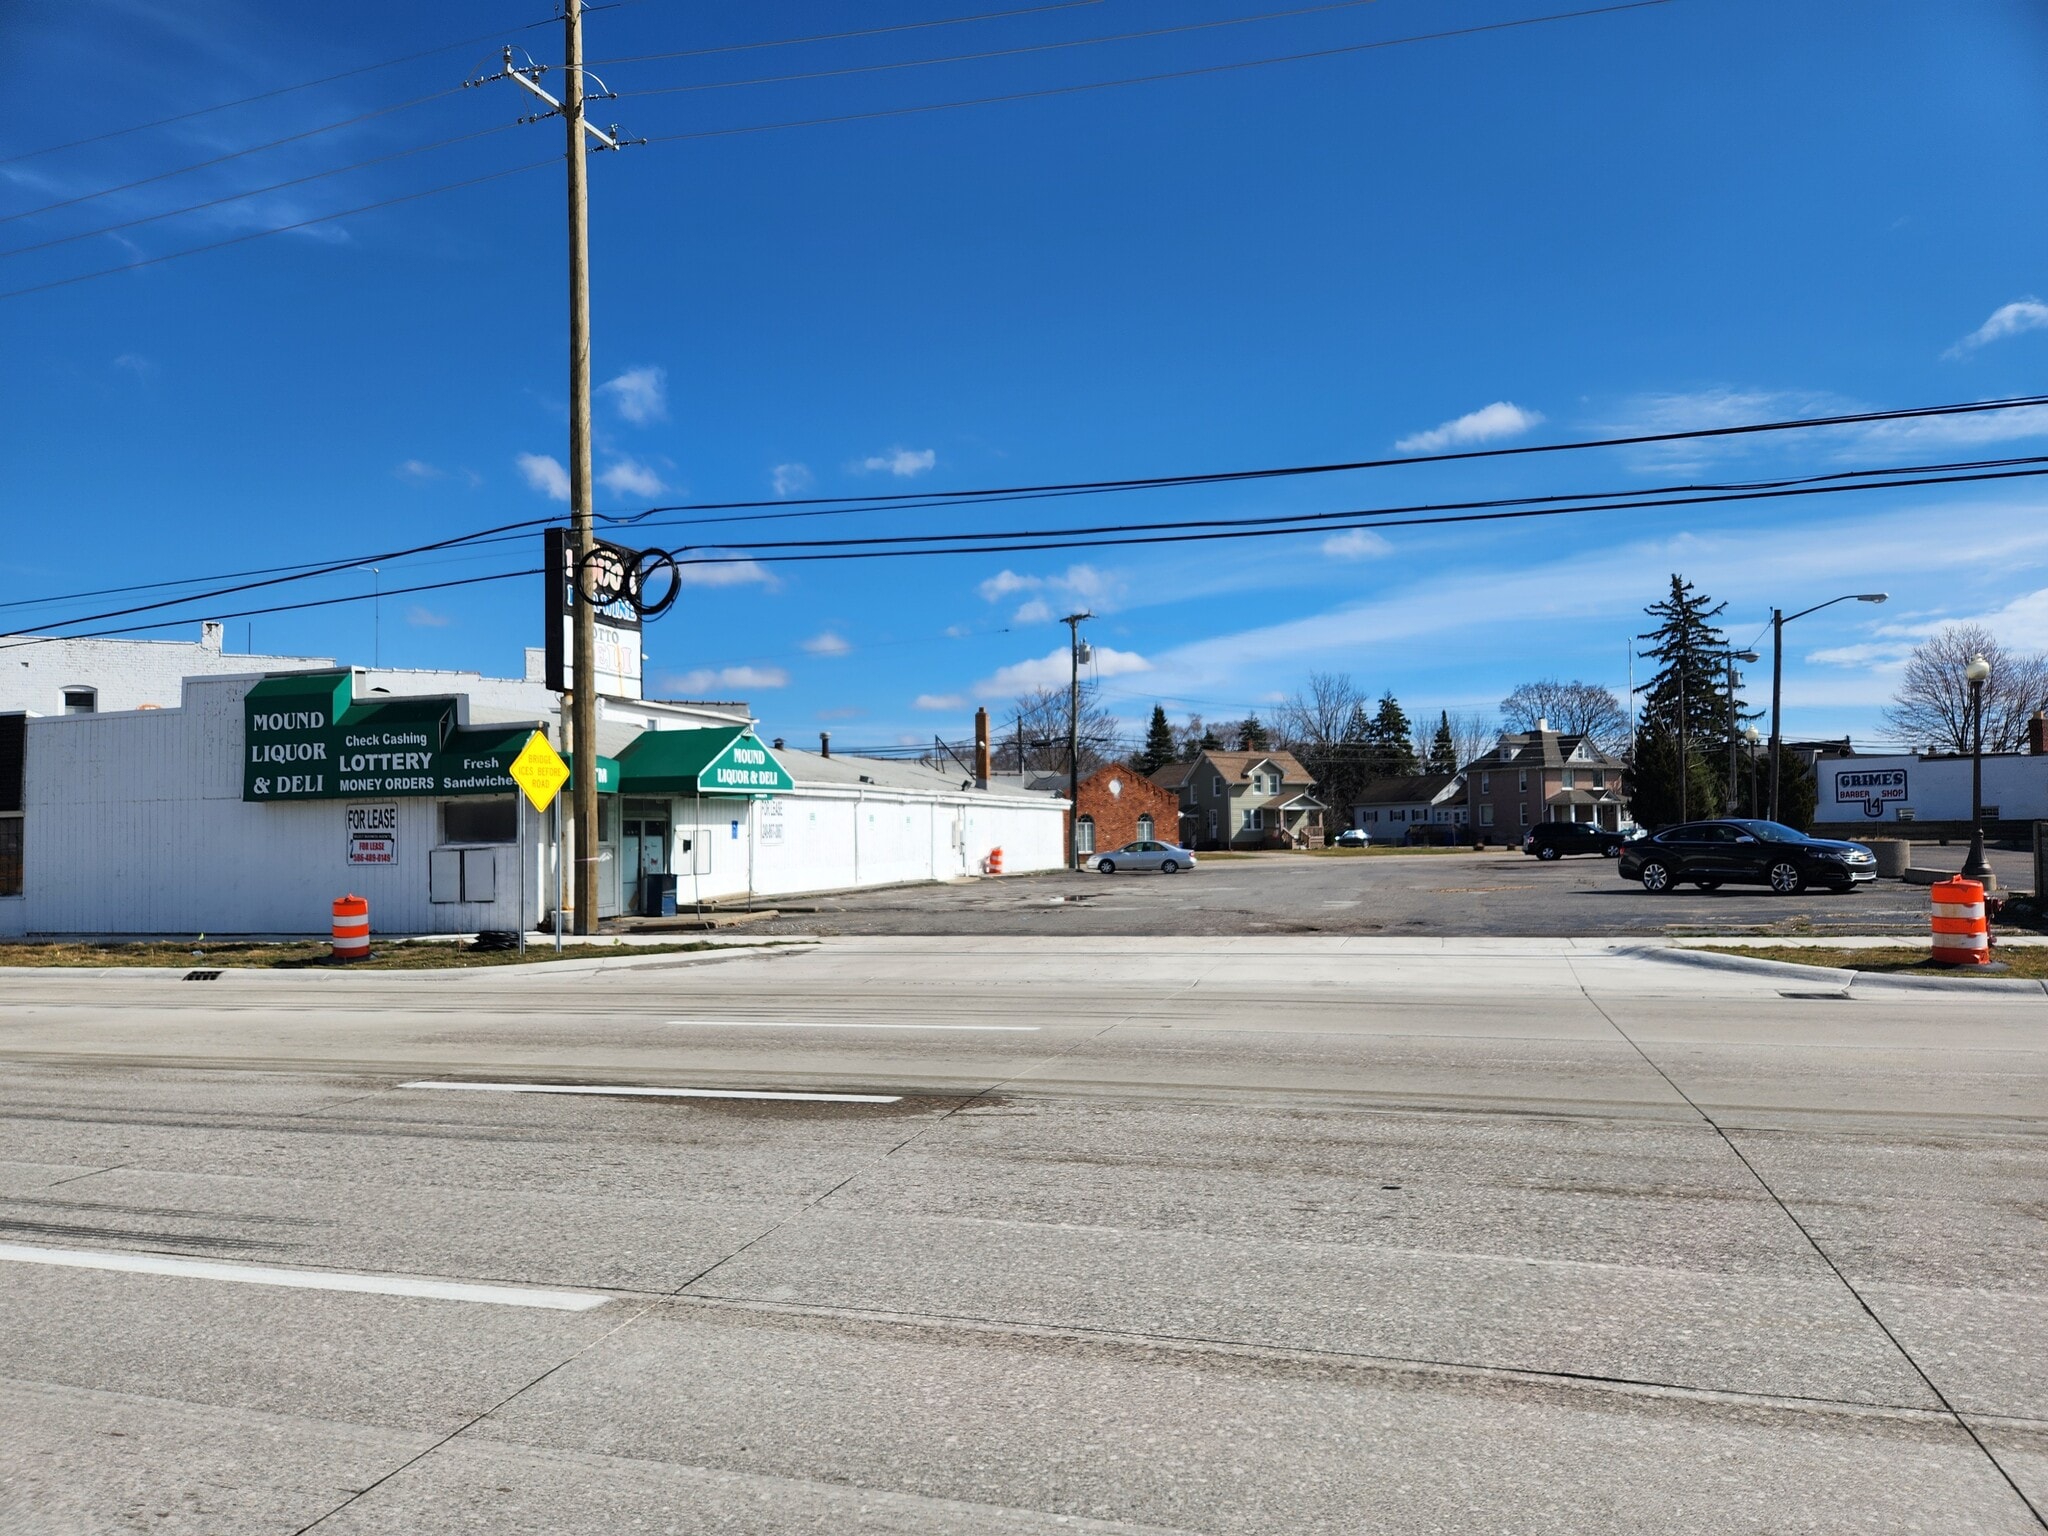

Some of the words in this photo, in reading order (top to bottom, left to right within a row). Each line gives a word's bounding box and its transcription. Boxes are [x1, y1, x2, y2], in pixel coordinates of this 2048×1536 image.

[253, 711, 325, 731] MOUND
[345, 734, 380, 747] Check
[382, 732, 427, 746] Cashing
[252, 742, 327, 764] LIQUOR
[528, 754, 552, 765] BRIDGE
[733, 748, 765, 764] MOUND
[339, 752, 433, 772] LOTTERY
[463, 757, 499, 770] Fresh
[518, 766, 534, 776] ICES
[537, 768, 561, 777] BEFORE
[717, 768, 749, 785] LIQUOR
[750, 770, 757, 784] &
[759, 771, 778, 785] DELI
[253, 777, 271, 794] &
[276, 774, 324, 793] DELI
[340, 778, 382, 791] MONEY
[385, 777, 434, 790] ORDERS
[532, 779, 550, 789] ROAD
[1839, 790, 1870, 799] BARBER
[1881, 789, 1903, 798] SHOP
[1867, 798, 1880, 813] 14
[348, 809, 366, 829] FOR
[367, 808, 396, 829] LEASE
[359, 842, 369, 850] FOR
[370, 842, 385, 851] LEASE
